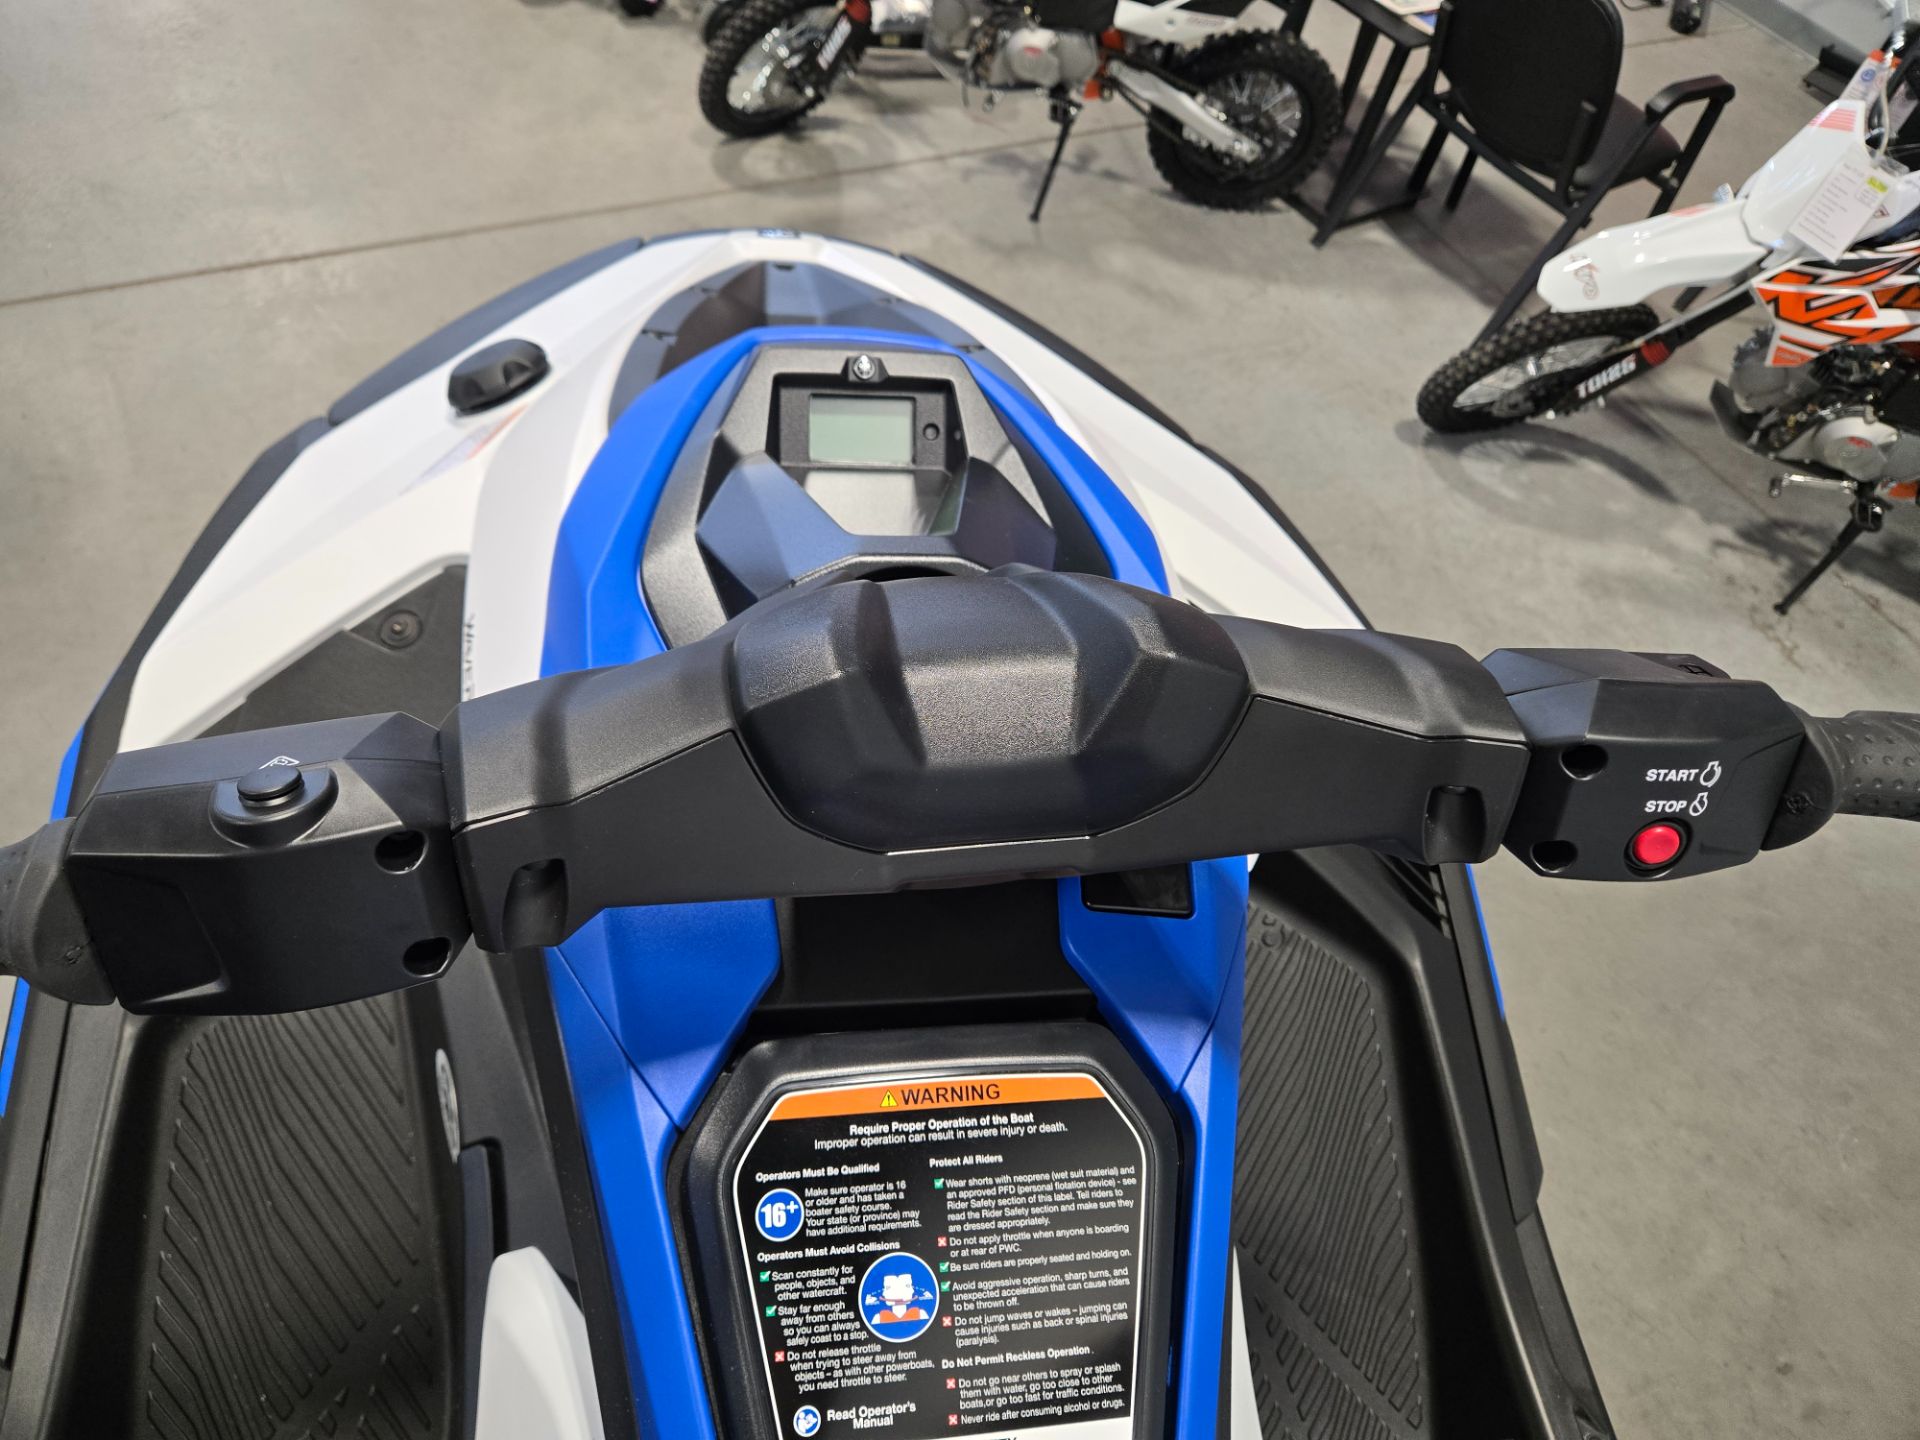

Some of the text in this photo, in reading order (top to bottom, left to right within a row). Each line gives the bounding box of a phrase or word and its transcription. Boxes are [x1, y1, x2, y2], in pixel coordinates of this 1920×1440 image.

[1645, 768, 1700, 783] START
[1644, 800, 1688, 814] STOP
[901, 1083, 1001, 1106] WARNING
[850, 1113, 1033, 1137] Require Proper Operation of the Boat
[815, 1139, 858, 1151] Improper
[860, 1134, 906, 1148] operation
[908, 1134, 926, 1143] can
[927, 1130, 954, 1141] result
[956, 1129, 965, 1139] in
[967, 1129, 998, 1139] severe
[999, 1126, 1025, 1138] injury
[1026, 1126, 1037, 1134] or
[929, 1155, 1003, 1167] Protect All Riders
[756, 1163, 880, 1183] Operators Must Be Qualified
[946, 1165, 1135, 1188] Wear shorts with neoprene (wet suit material) and
[805, 1181, 906, 1197] Make sure operator is 16
[946, 1191, 956, 1199] an
[958, 1186, 996, 1200] approved
[997, 1185, 1015, 1195] PFD
[1016, 1182, 1053, 1196] (personal
[1087, 1178, 1115, 1188] device)
[1122, 1178, 1137, 1186] see
[761, 1201, 799, 1229] 16+
[805, 1206, 832, 1216] boater
[834, 1204, 859, 1214] safety
[806, 1210, 920, 1226] Your state (or province) may
[948, 1198, 1134, 1220] read the Rider Safety section and make sure they
[806, 1227, 825, 1236] have
[827, 1223, 866, 1235] additional
[948, 1224, 961, 1232] are
[963, 1220, 995, 1231] dressed
[950, 1224, 1130, 1246] Do not apply throttle when anyone is boarding
[757, 1241, 900, 1263] Operators Must Avoid Collisions
[950, 1262, 961, 1271] Be
[962, 1262, 979, 1270] sure
[980, 1259, 1002, 1269] riders
[1003, 1259, 1016, 1267] are
[1017, 1255, 1047, 1268] properly
[1049, 1252, 1074, 1263] seated
[1075, 1251, 1090, 1261] and
[1091, 1249, 1118, 1260] holding
[772, 1265, 853, 1280] Scan constantly for
[839, 1275, 856, 1285] and
[952, 1280, 975, 1290] Avoid
[977, 1277, 1020, 1290] aggressive
[1064, 1271, 1087, 1281] sharp
[1113, 1266, 1129, 1276] and
[777, 1291, 800, 1300] other
[953, 1288, 999, 1301] unexpected
[1001, 1284, 1048, 1296] acceleration
[1050, 1282, 1065, 1292] that
[1083, 1280, 1106, 1289] cause
[1107, 1277, 1130, 1287] riders
[778, 1301, 846, 1316] Stay far enough
[780, 1311, 855, 1326] away from others
[786, 1343, 882, 1361] Do not release throttle
[790, 1351, 917, 1370] when trying to steer away from
[941, 1347, 1090, 1368] Do Not Permit Reckless Operation
[995, 1397, 1007, 1407] go
[1008, 1394, 1023, 1403] too
[1024, 1391, 1040, 1402] fast
[1042, 1391, 1053, 1400] for
[1055, 1388, 1078, 1398] traffic
[826, 1401, 917, 1420] Read Operator's
[961, 1415, 983, 1424] Never
[985, 1412, 1000, 1421] ride
[1001, 1410, 1019, 1420] after
[1020, 1406, 1062, 1418] consuming
[1063, 1402, 1090, 1413] alcohol
[852, 1415, 894, 1429] Manual
